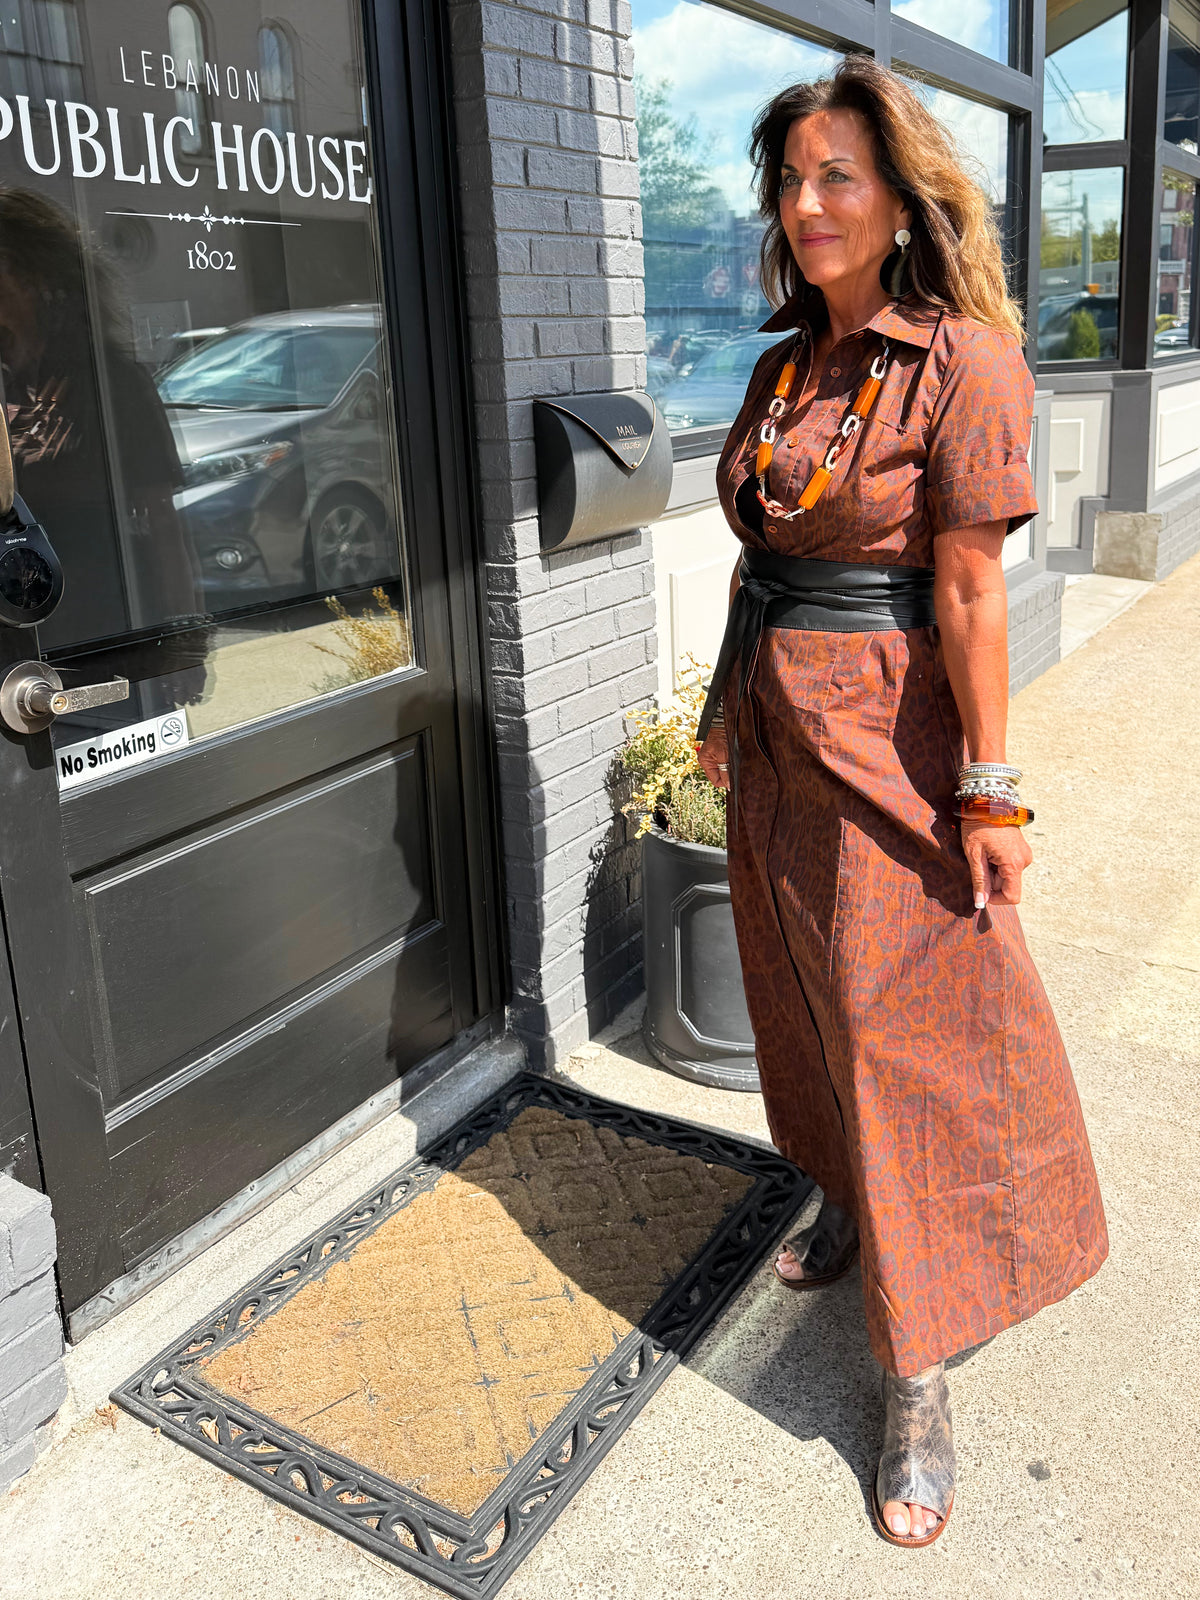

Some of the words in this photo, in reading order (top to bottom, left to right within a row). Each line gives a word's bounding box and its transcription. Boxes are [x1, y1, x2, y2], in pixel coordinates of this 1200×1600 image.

[120, 46, 261, 103] LEBANON
[210, 121, 372, 204] HOUSE
[187, 240, 237, 271] 1802
[616, 424, 638, 437] MAIL
[60, 754, 84, 778] No
[86, 732, 156, 769] Smoking
